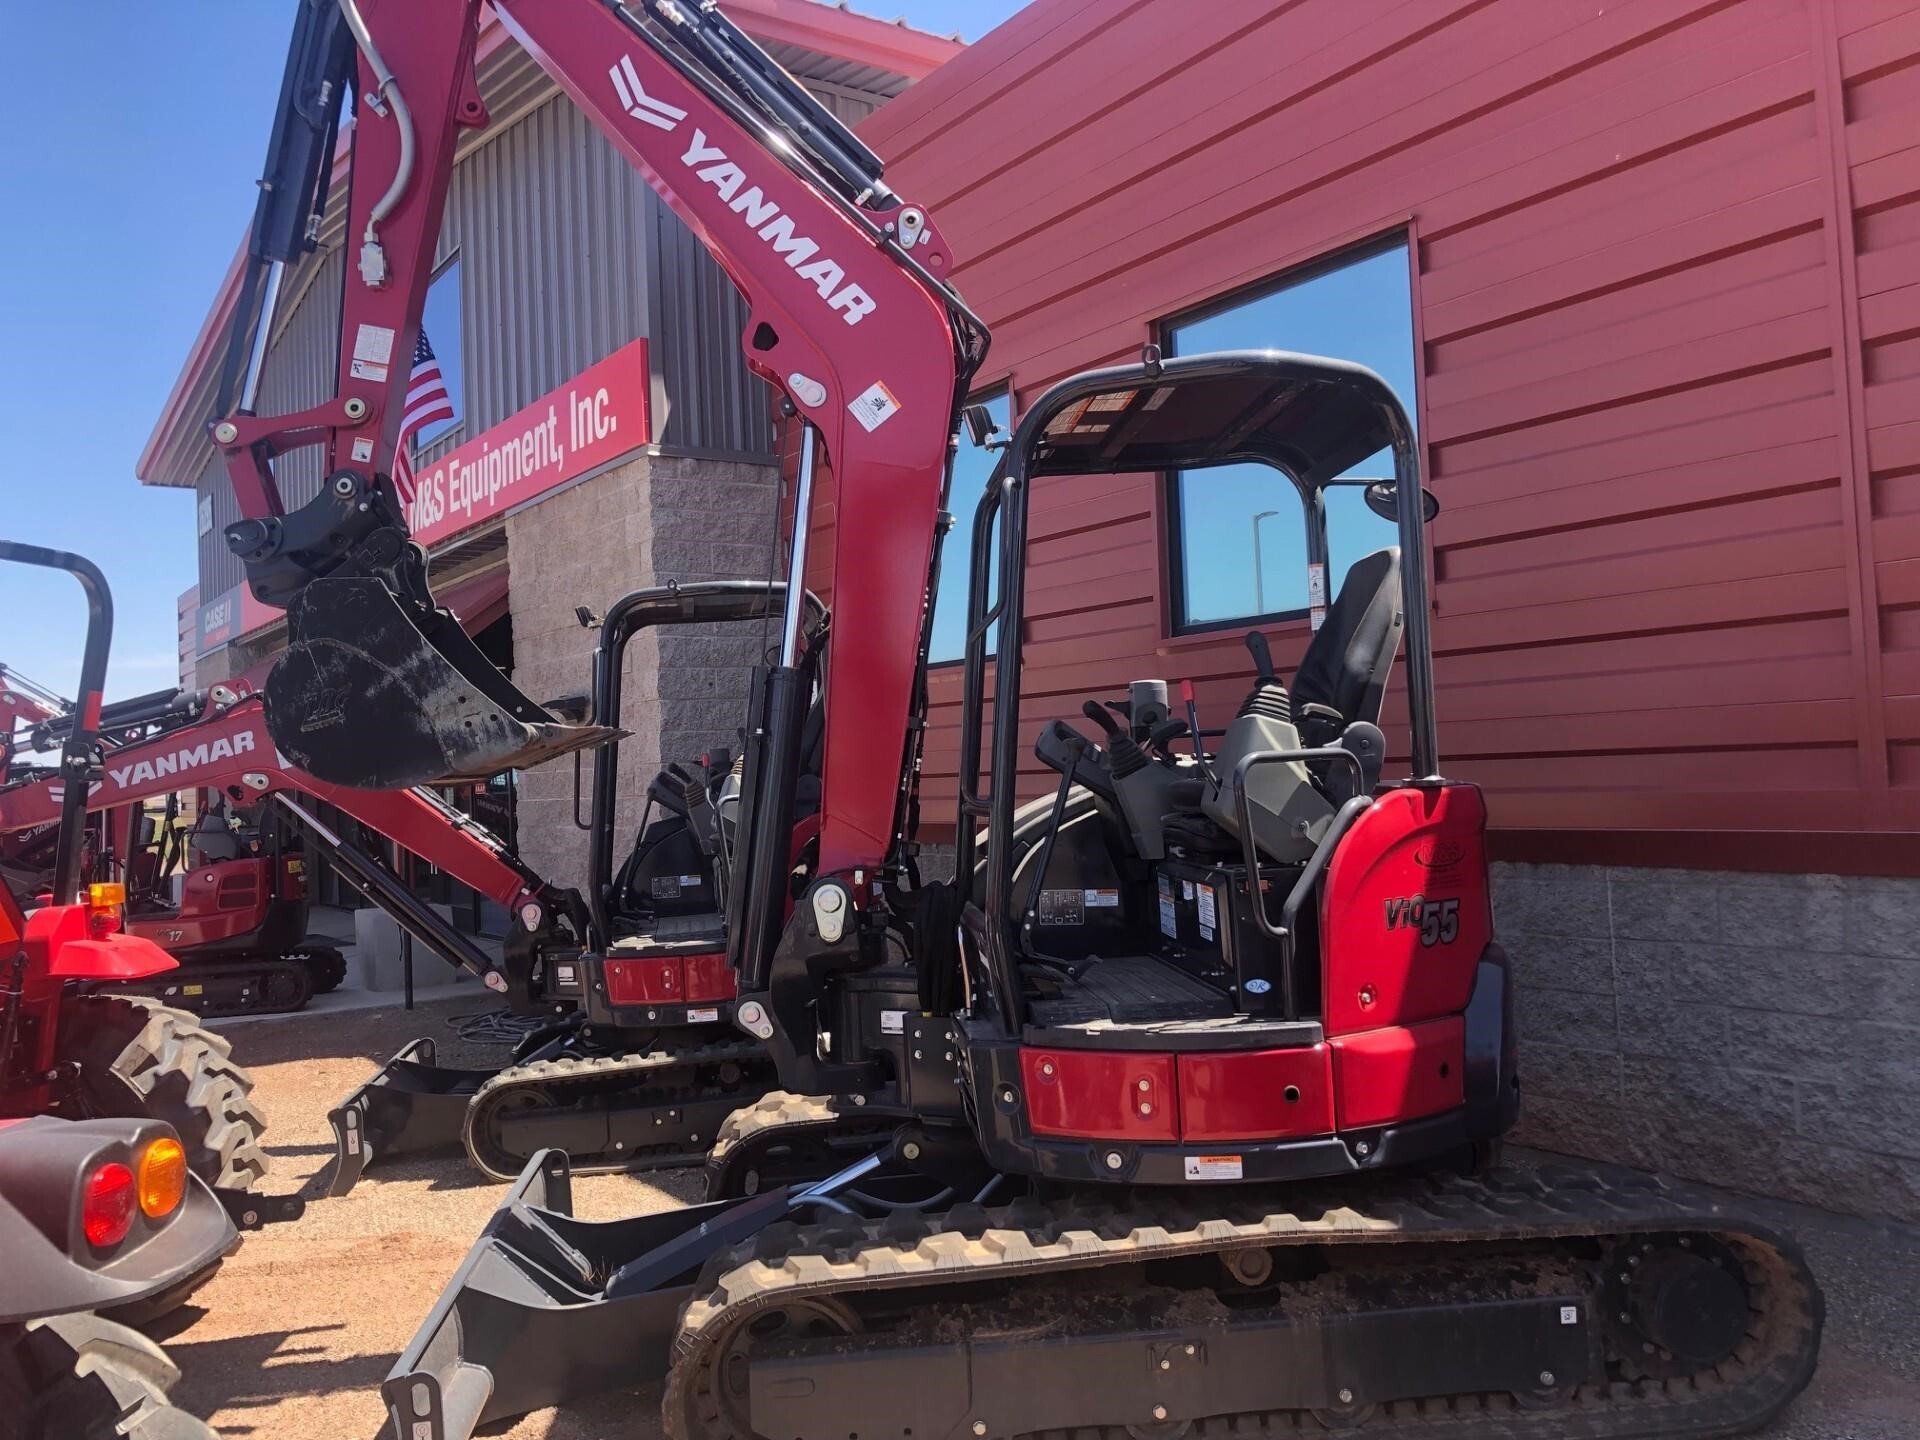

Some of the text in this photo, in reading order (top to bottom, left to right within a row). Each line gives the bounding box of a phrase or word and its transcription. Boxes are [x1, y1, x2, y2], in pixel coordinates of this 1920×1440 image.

[680, 127, 877, 326] YANMAR
[409, 387, 617, 534] M&S Equipment, Inc.
[109, 730, 255, 789] YANMAR
